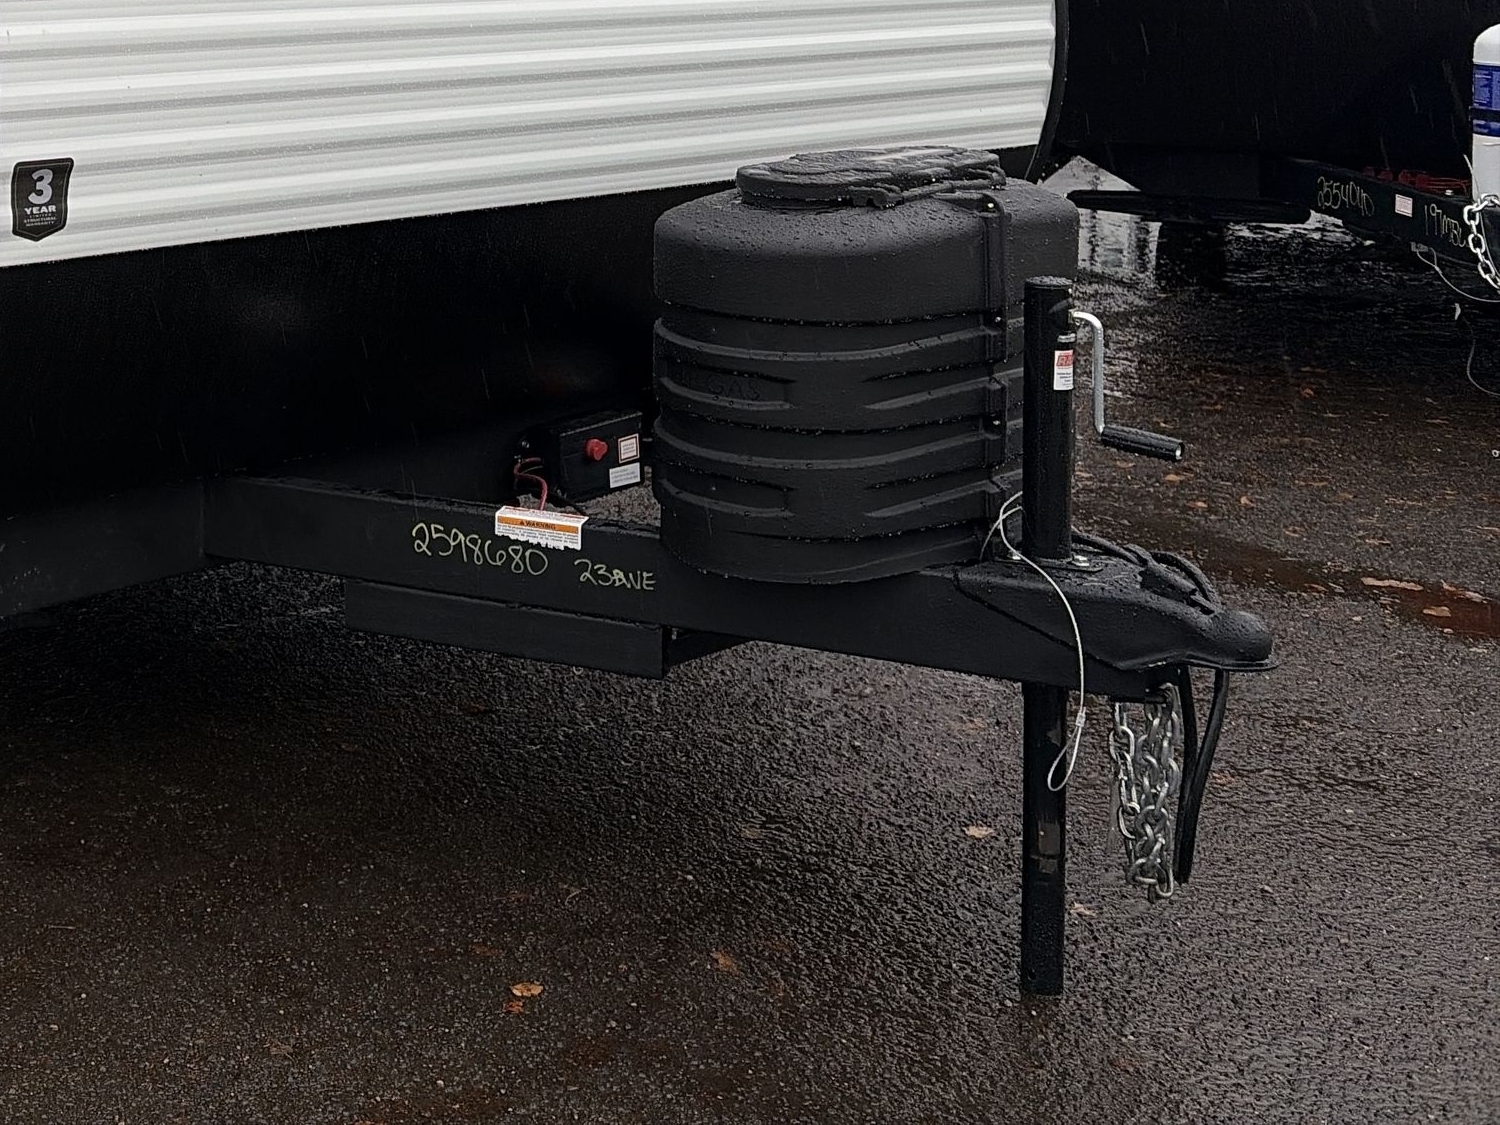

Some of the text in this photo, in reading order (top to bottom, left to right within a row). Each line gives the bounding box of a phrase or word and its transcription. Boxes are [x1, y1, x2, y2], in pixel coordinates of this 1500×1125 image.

[28, 168, 53, 205] 3
[24, 205, 56, 215] YEAR
[525, 519, 557, 531] WARNING
[411, 522, 549, 576] 2598680
